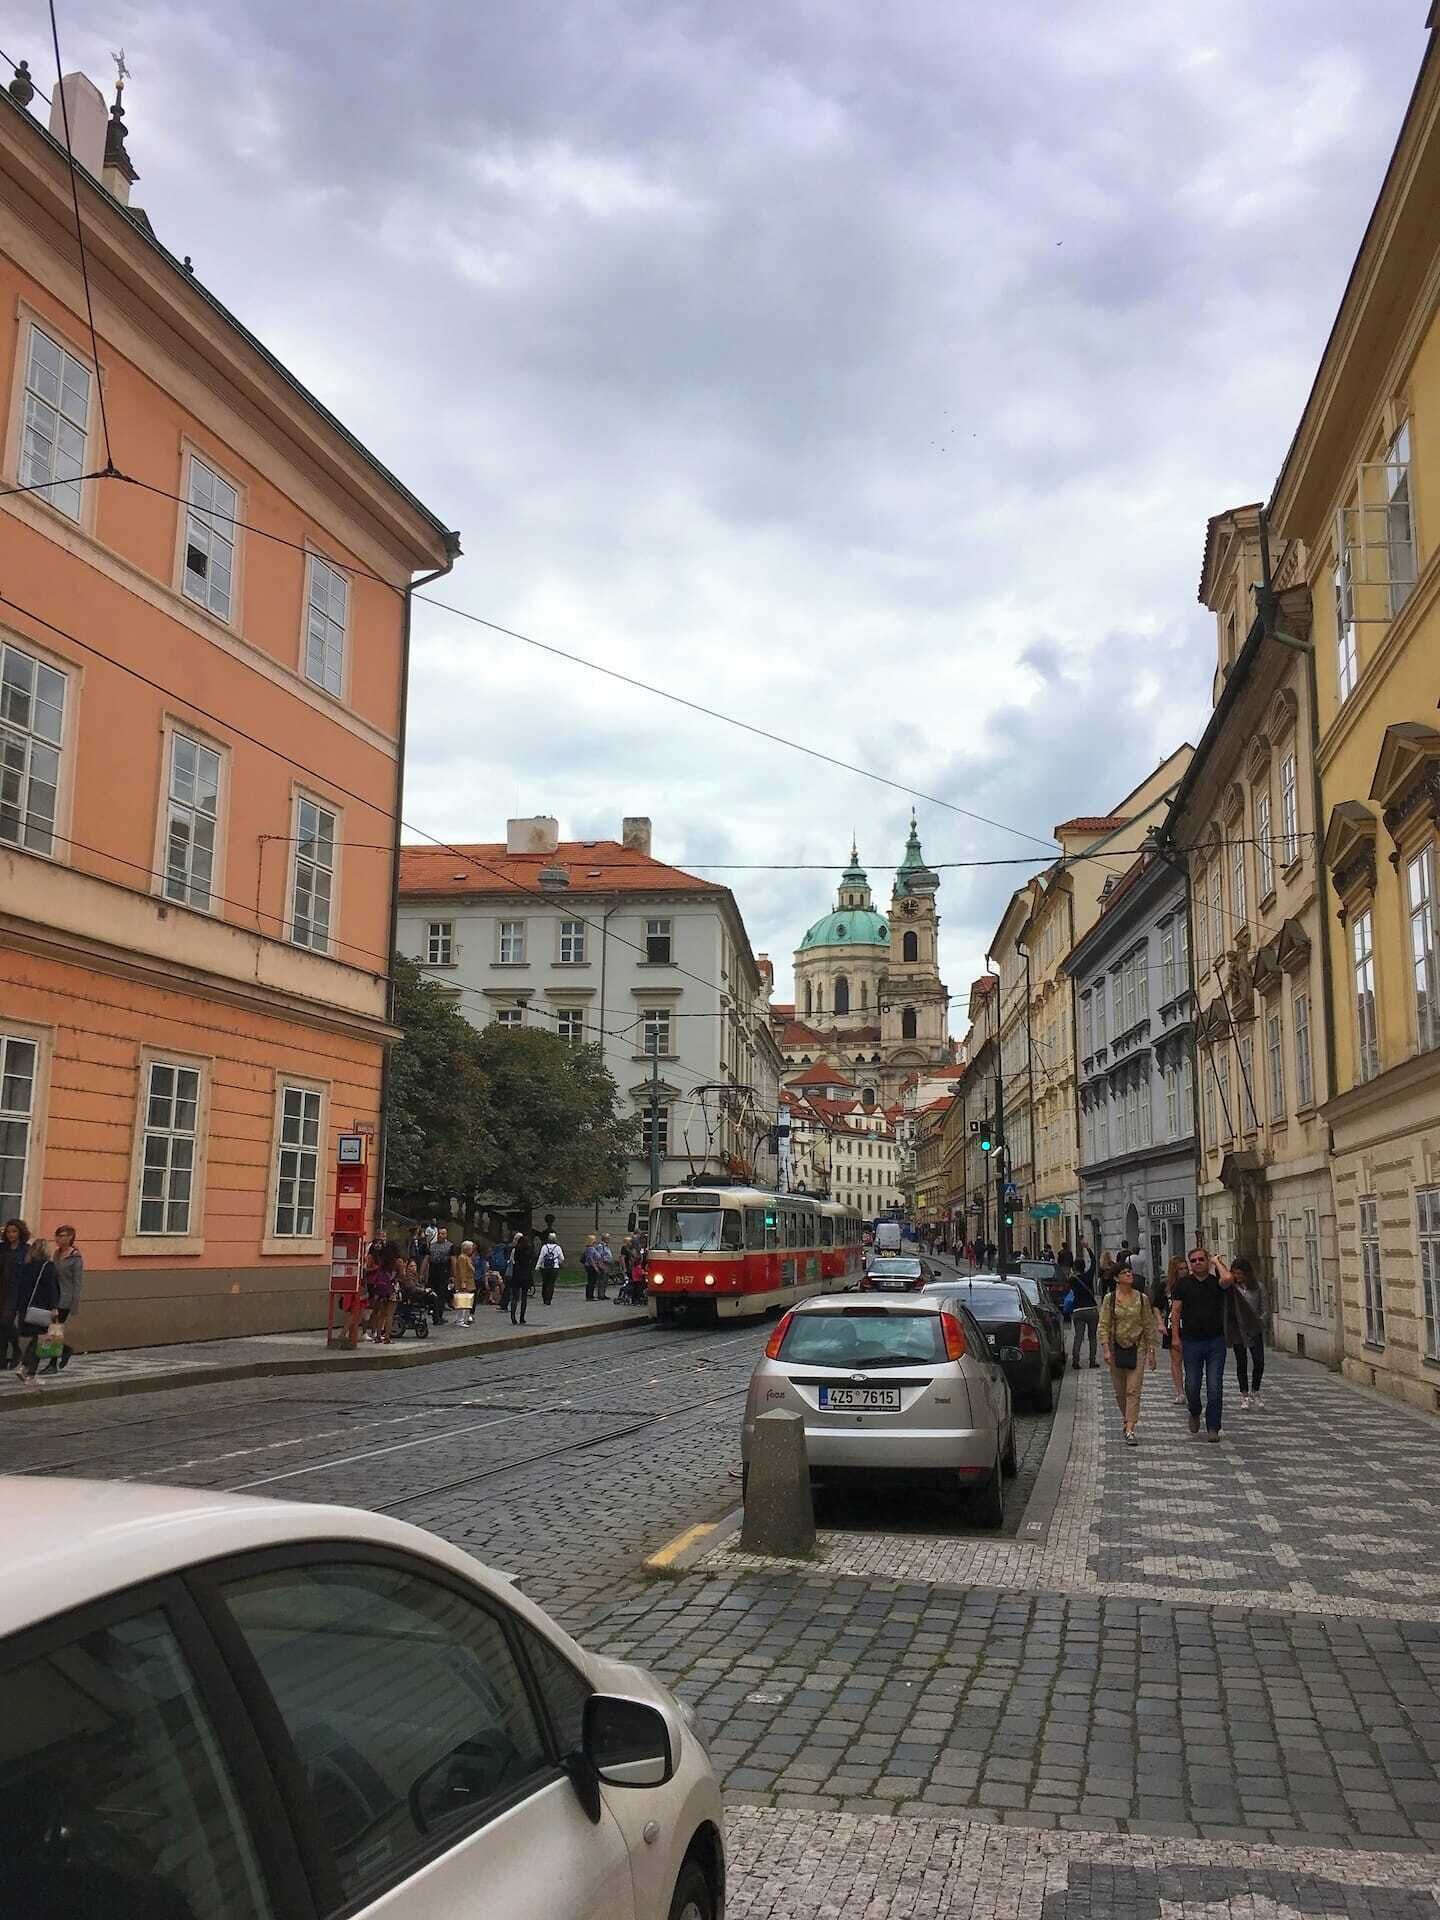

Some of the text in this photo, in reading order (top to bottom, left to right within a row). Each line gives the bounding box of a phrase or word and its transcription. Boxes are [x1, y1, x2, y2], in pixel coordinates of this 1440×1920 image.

[675, 1275, 695, 1285] 8157
[830, 1390, 853, 1404] 4Z5
[863, 1390, 894, 1404] 7615
